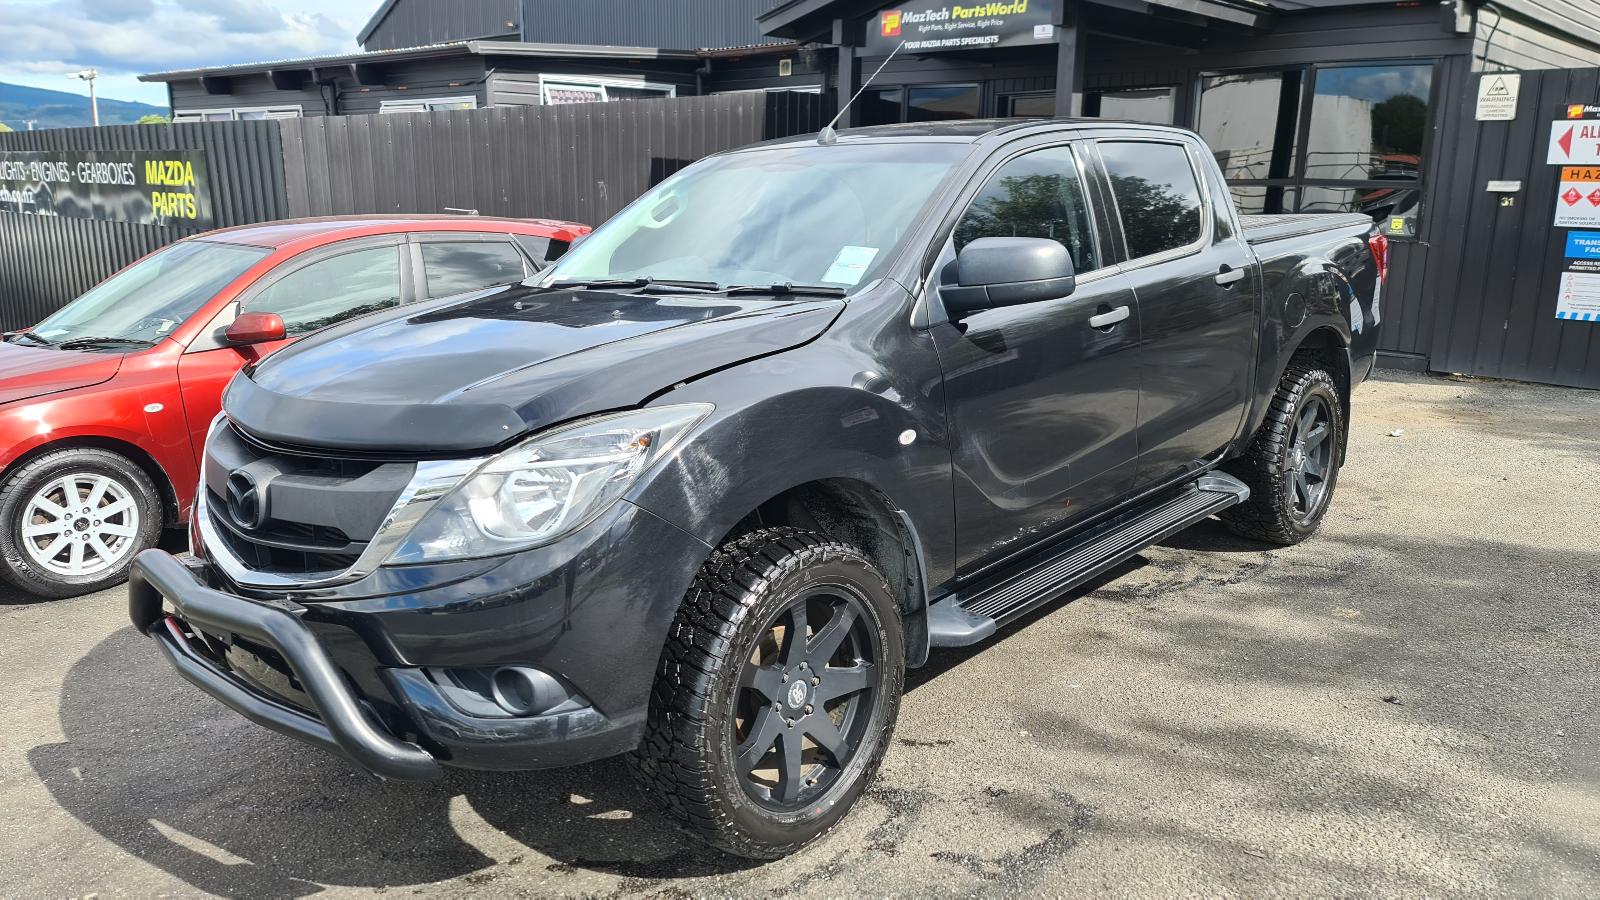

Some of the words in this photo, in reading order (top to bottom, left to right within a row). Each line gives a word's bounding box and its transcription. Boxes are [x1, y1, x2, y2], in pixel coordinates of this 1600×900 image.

[901, 8, 949, 24] MazTech
[952, 0, 1028, 19] PartsWorld
[918, 25, 931, 33] Right
[944, 22, 957, 32] Right
[977, 20, 990, 29] Right
[991, 19, 1004, 27] Price
[904, 40, 920, 49] YOUR
[921, 39, 941, 48] MAZDA
[942, 37, 961, 47] PARTS
[961, 35, 999, 45] SPECIALISTS
[30, 161, 70, 182] ENGINES
[77, 162, 136, 186] GEARBOXES
[145, 160, 195, 186] MAZDA
[152, 192, 197, 220] PARTS
